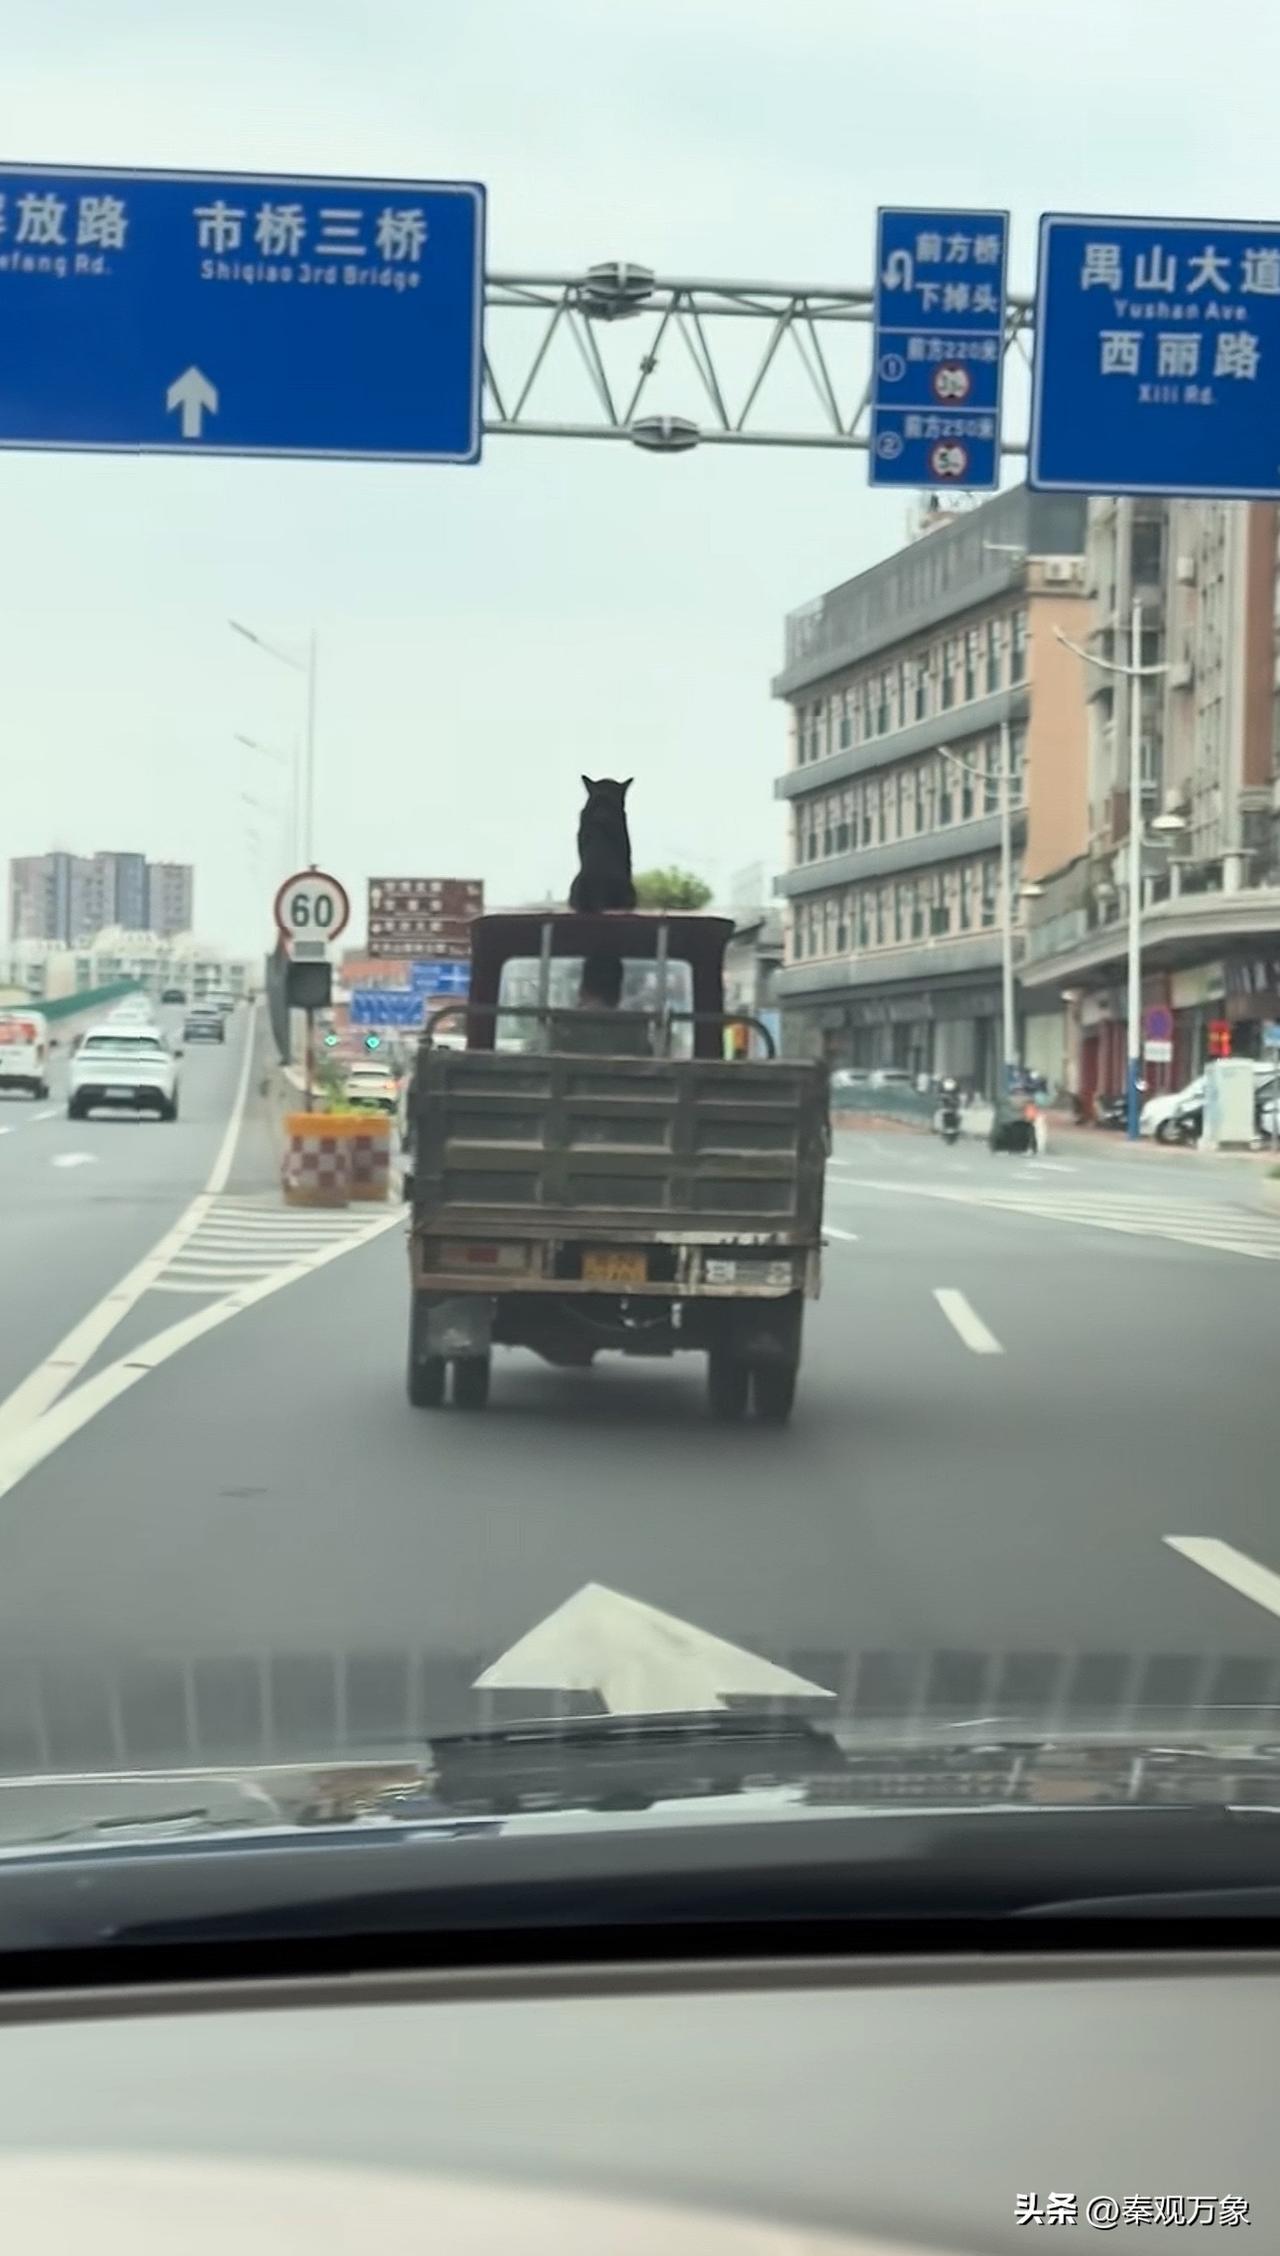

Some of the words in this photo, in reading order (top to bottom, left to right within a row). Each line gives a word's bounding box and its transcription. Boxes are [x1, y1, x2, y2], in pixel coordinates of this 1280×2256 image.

[0, 193, 128, 249] 放路
[194, 201, 427, 262] 市桥三桥
[916, 232, 999, 265] 前方桥
[201, 259, 292, 284] Shiqiao
[299, 264, 337, 283] 3rd
[344, 265, 420, 292] Bridge
[1081, 243, 1280, 296] 禺山大道
[915, 282, 998, 313] 下掉头
[1114, 299, 1200, 320] Yushan
[1099, 330, 1261, 381] 西丽路
[1138, 384, 1179, 403] Xili
[291, 893, 334, 928] 60
